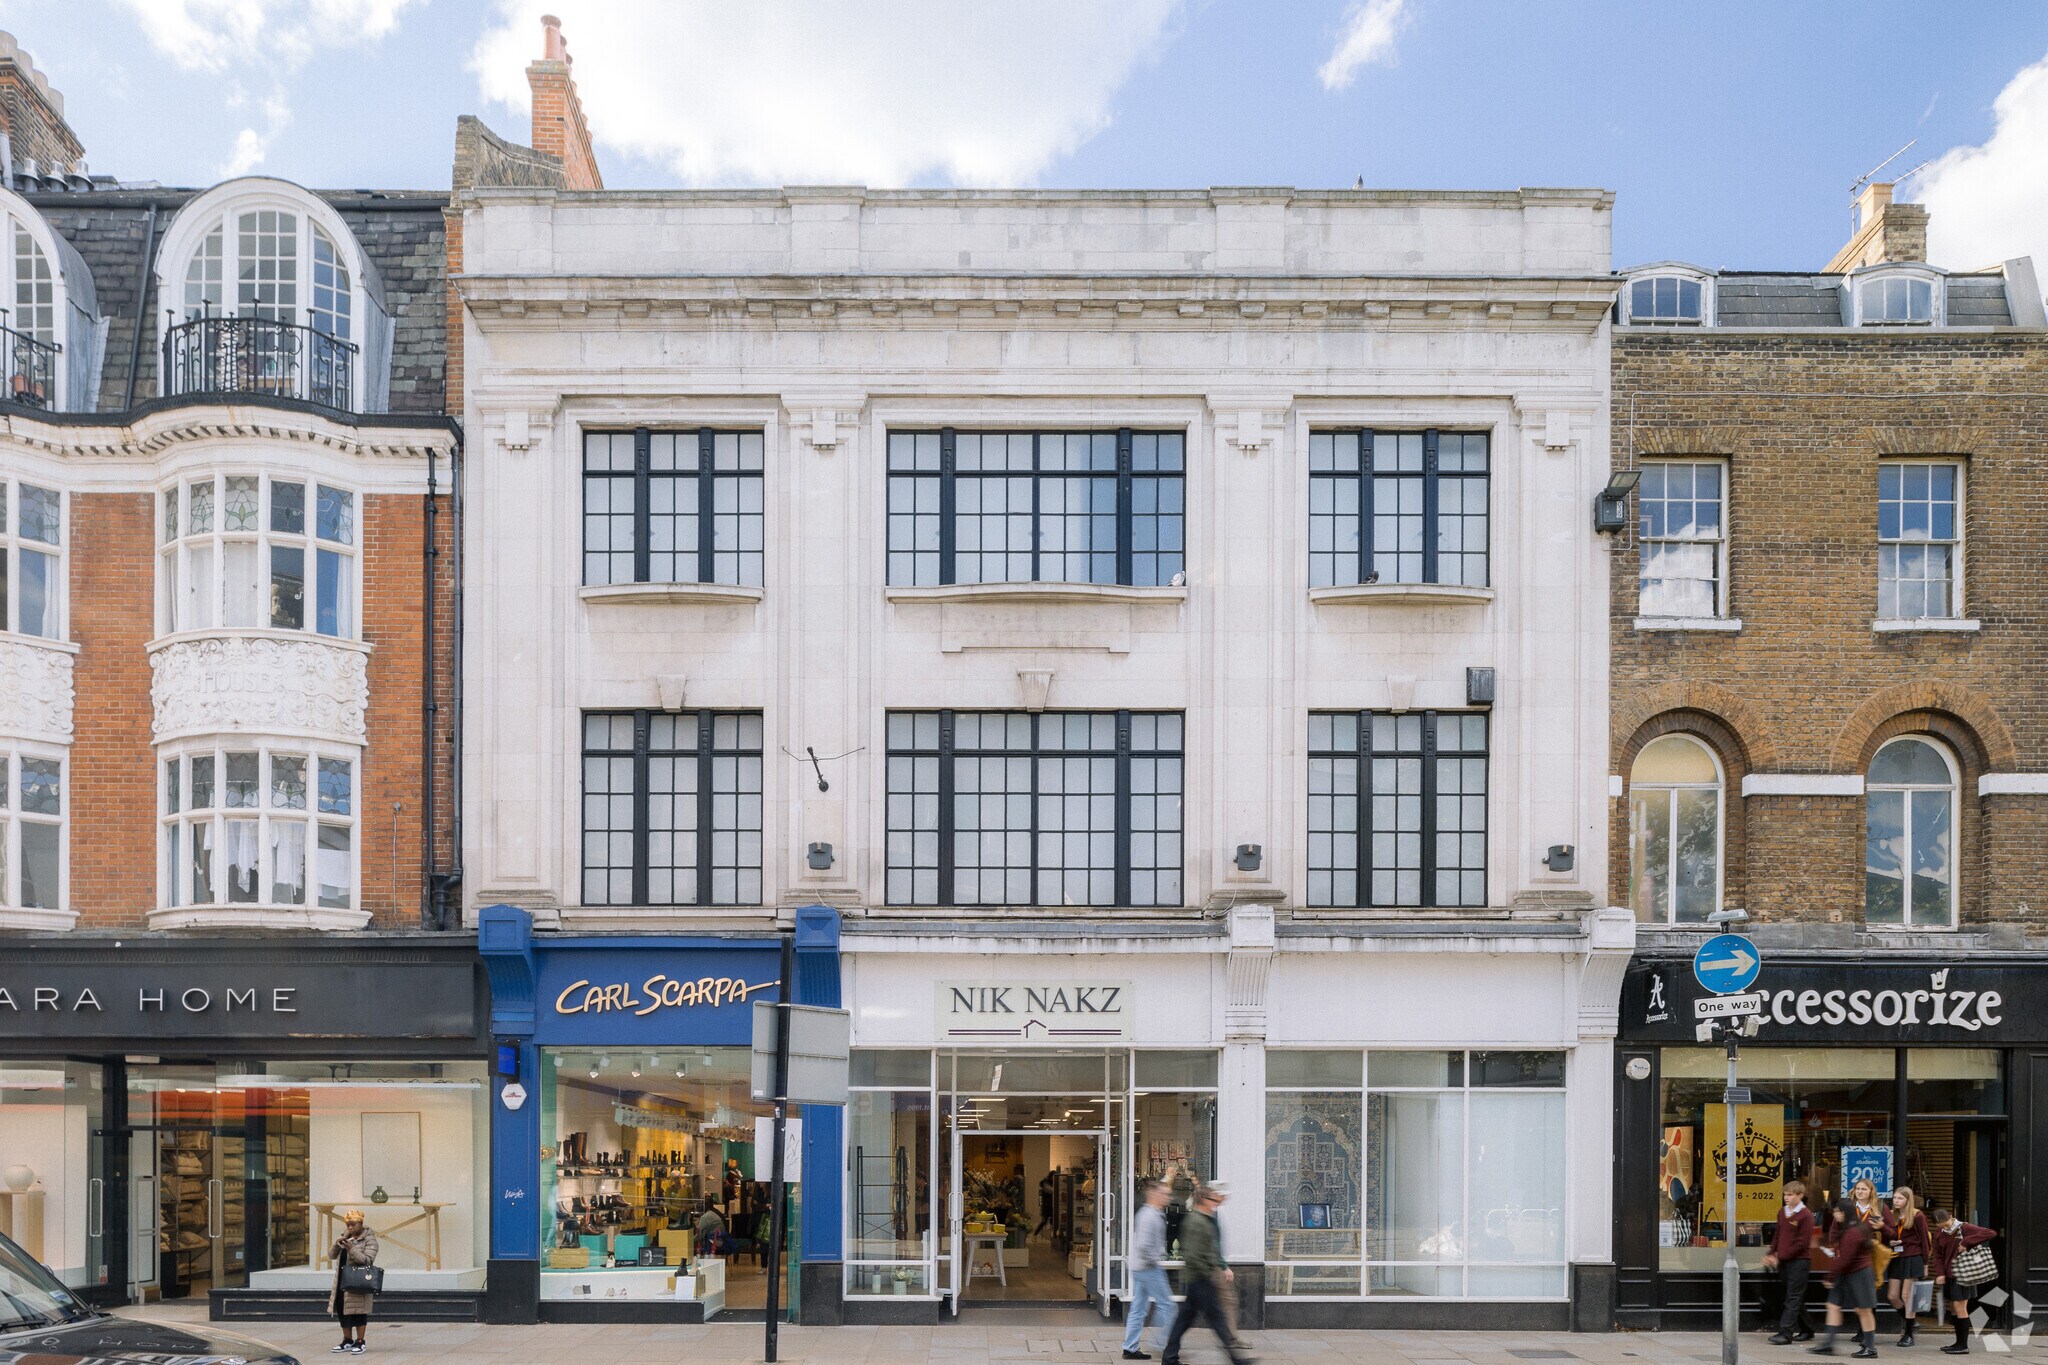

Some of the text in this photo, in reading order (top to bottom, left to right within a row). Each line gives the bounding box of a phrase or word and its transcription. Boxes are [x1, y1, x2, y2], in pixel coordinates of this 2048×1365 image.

[203, 671, 273, 693] HOUSE
[139, 988, 296, 1012] HOME
[555, 979, 640, 1014] CARL
[950, 987, 1122, 1013] NIK NAKZ
[1648, 974, 1665, 1009] A
[1702, 968, 2001, 1036] ccessorize
[1698, 1000, 1757, 1012] One way
[1722, 1192, 1743, 1200] 16
[1752, 1192, 1774, 1200] 2022
